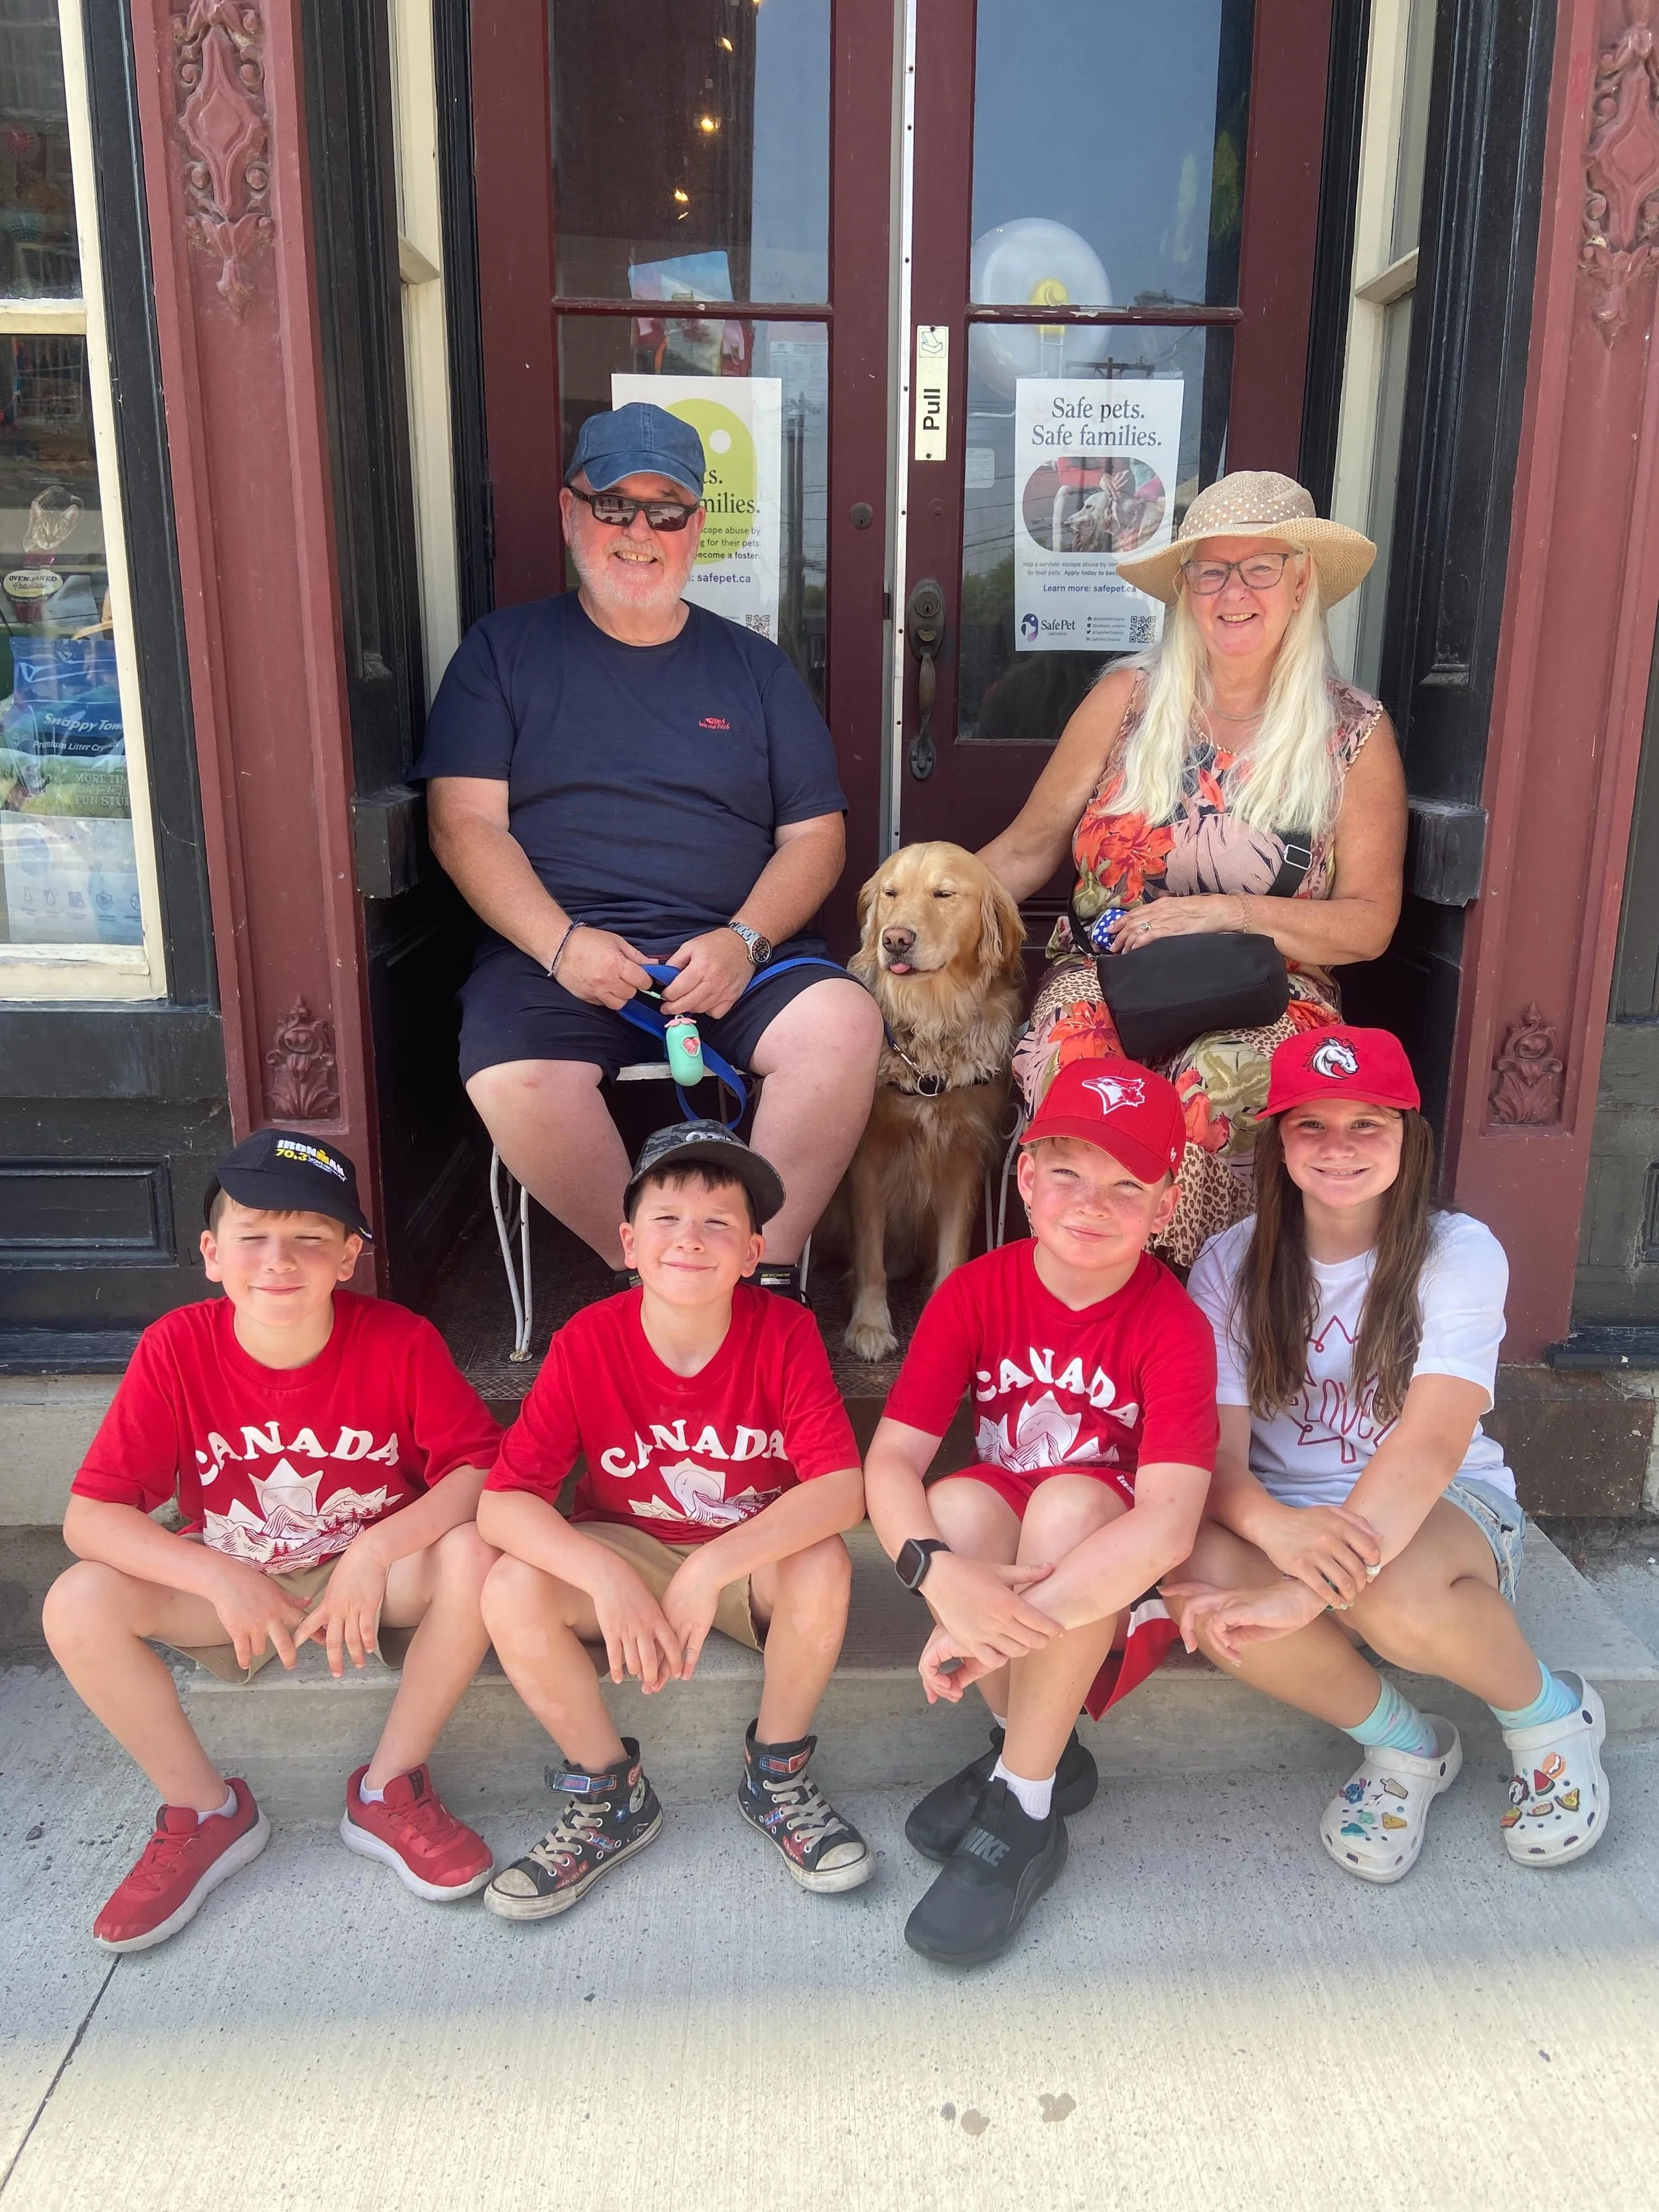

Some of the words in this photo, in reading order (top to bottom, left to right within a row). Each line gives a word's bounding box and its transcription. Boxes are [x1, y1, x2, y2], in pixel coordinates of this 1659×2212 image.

[923, 389, 940, 430] Pull
[1052, 396, 1093, 418] Safe
[1099, 399, 1145, 423] pets.
[1031, 423, 1072, 445] Safe
[1078, 423, 1161, 446] families.
[703, 469, 723, 484] ts.
[701, 492, 760, 514] milies.
[700, 527, 723, 536] cape
[751, 527, 761, 536] by
[697, 573, 751, 585] safepet.ca
[1094, 585, 1137, 594] safepet.ca
[1041, 619, 1076, 630] SafePet
[44, 713, 98, 732] Snappy
[33, 741, 67, 750] Premium
[75, 773, 106, 783] MORE
[108, 774, 127, 784] TIM
[275, 1148, 308, 1161] 70.3
[277, 1140, 345, 1177] IRONMAN
[194, 1420, 399, 1486] CANADA
[600, 1419, 790, 1478] CANADA
[963, 1826, 1011, 1868] NIKE
